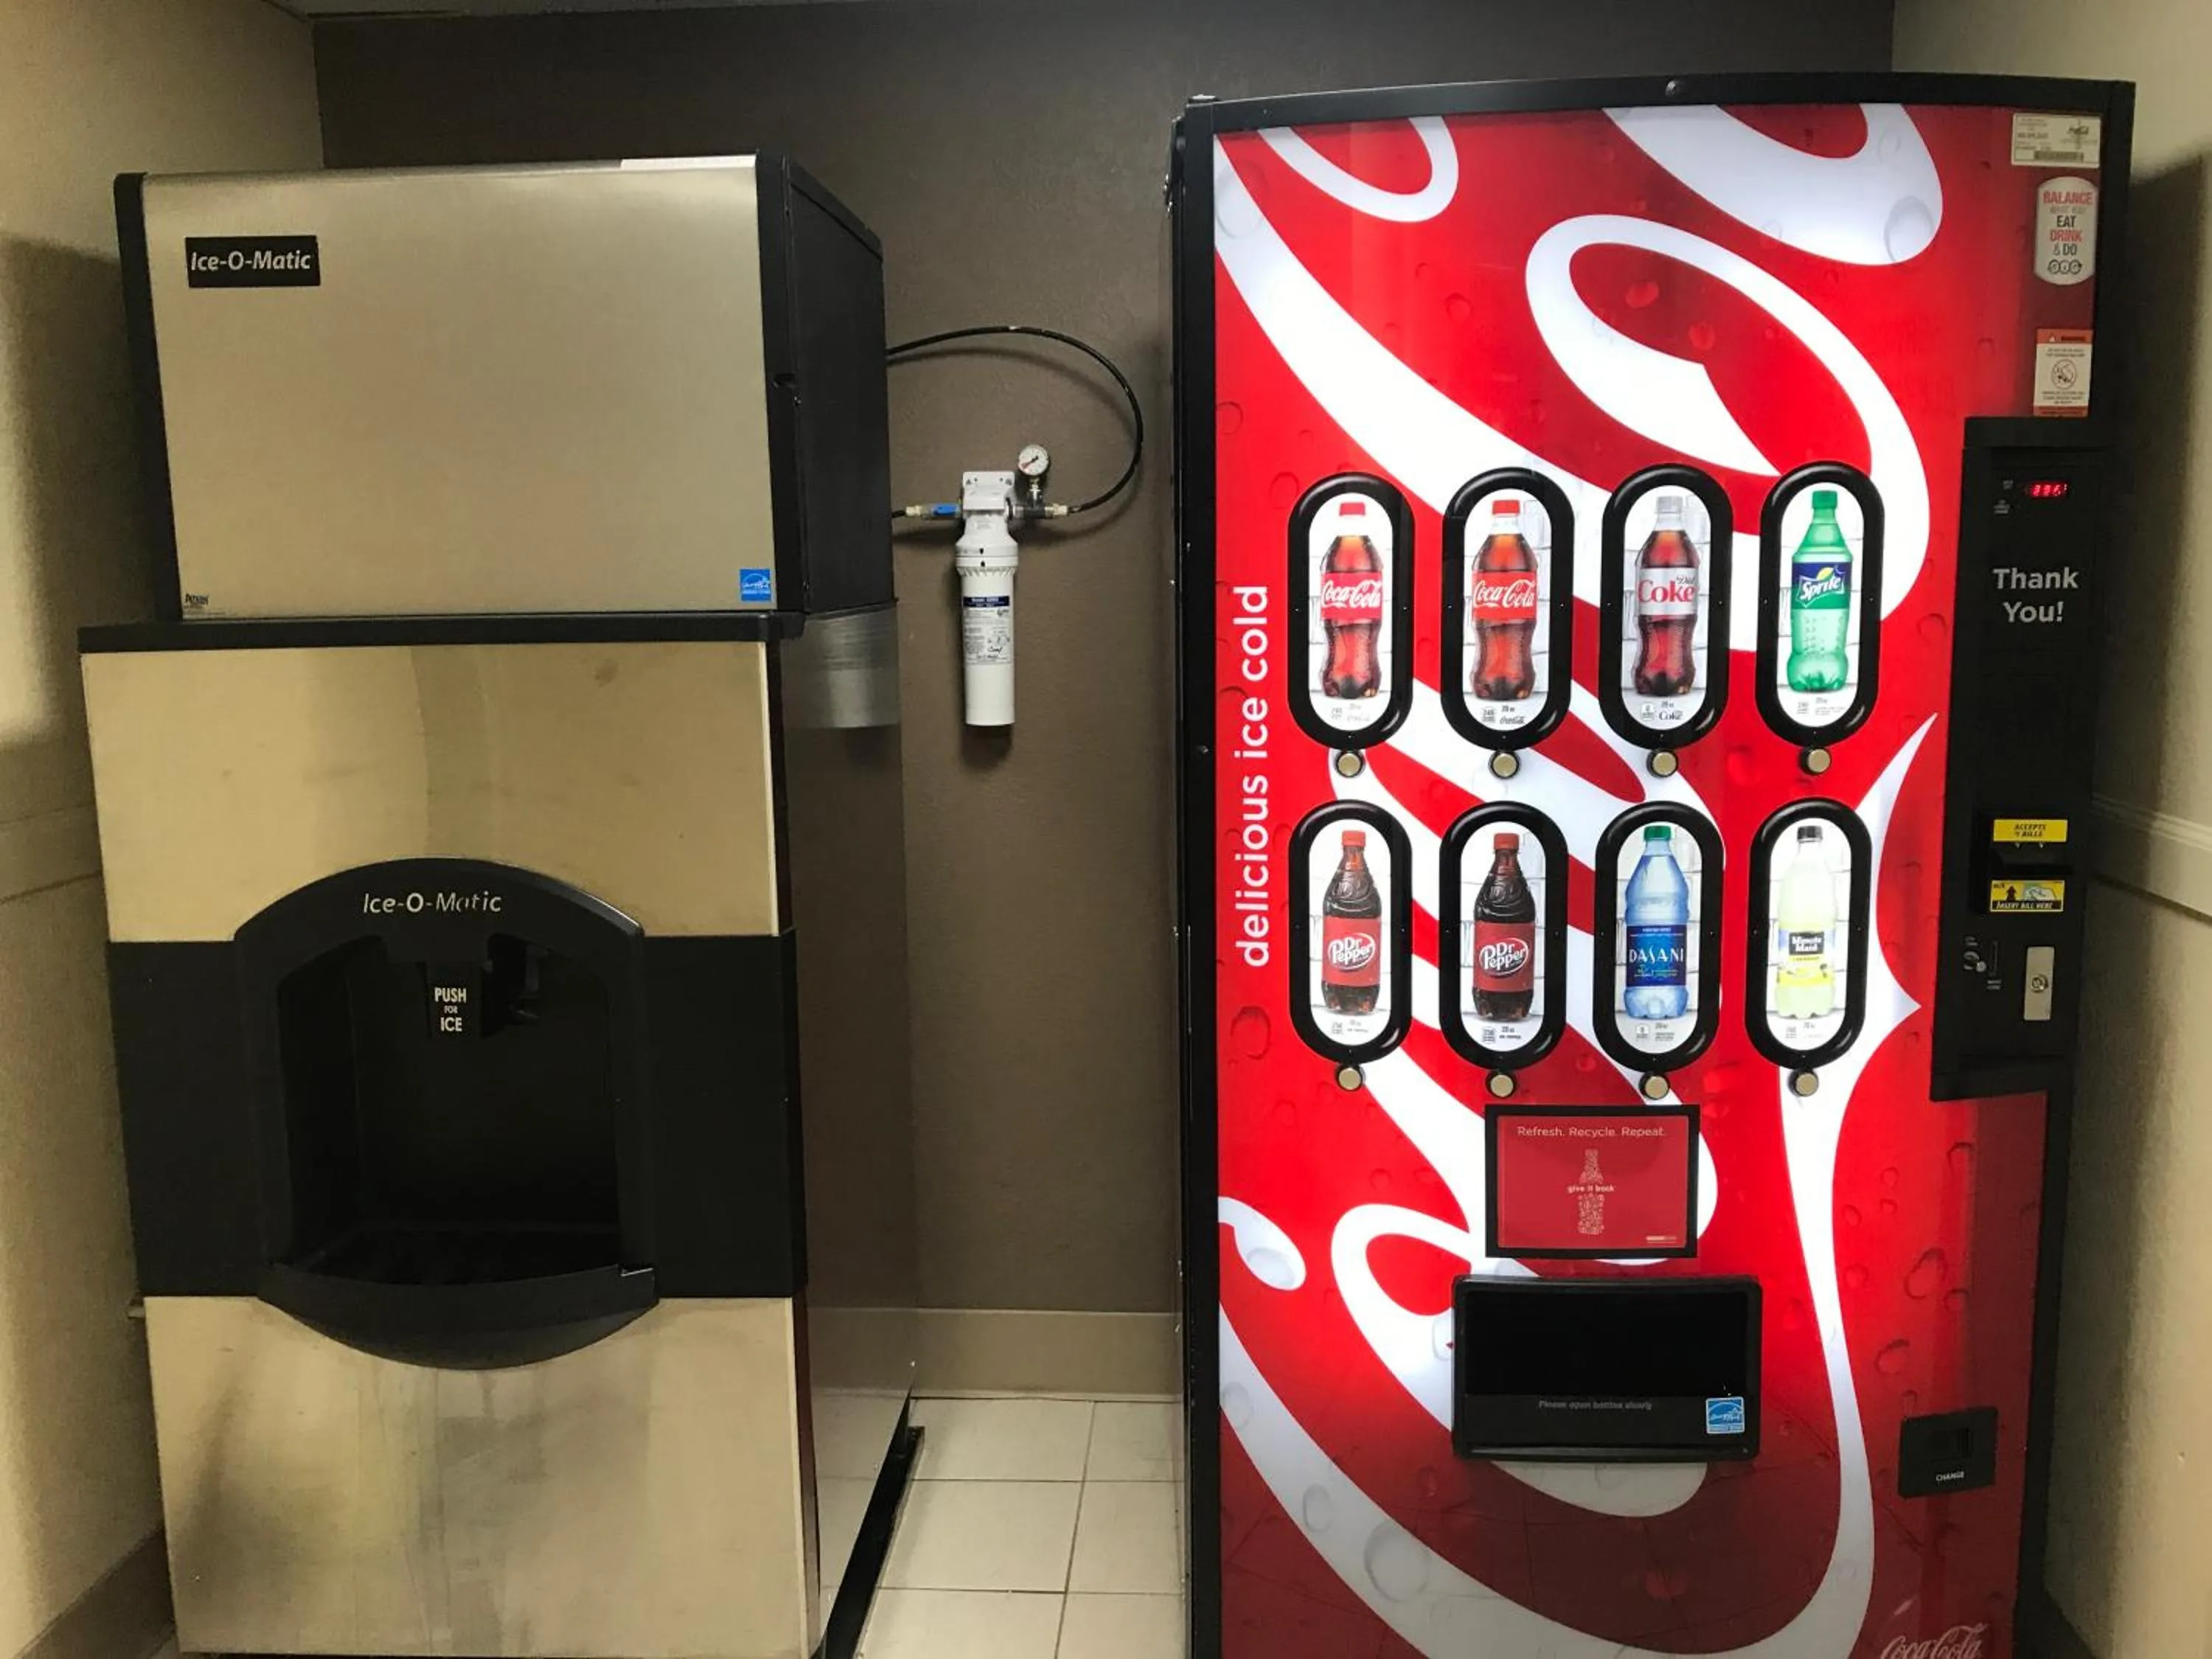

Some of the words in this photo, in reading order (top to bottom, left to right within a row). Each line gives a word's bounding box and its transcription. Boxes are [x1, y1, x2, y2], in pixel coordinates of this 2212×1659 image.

[2043, 191, 2093, 205] BALANCE
[2056, 215, 2076, 227] EAT
[2050, 229, 2083, 242] DRINK
[190, 249, 311, 271] Ice-O-Matic
[2062, 243, 2078, 256] DO
[1800, 573, 1841, 601] Sprite
[1993, 566, 2079, 591] Thank
[1321, 579, 1382, 609] Coca-Cola
[1473, 578, 1536, 609] Coca-Cola
[1638, 579, 1699, 603] Coke
[2003, 600, 2065, 623] You!
[1232, 586, 1268, 682] cold
[1234, 696, 1269, 759] ice
[1235, 773, 1270, 968] delicious
[364, 890, 502, 914] Ice-O-Matic
[1332, 939, 1371, 965] Pepper
[1344, 936, 1363, 950] Dr
[1496, 942, 1515, 956] Dr
[1484, 945, 1524, 970] Pepper
[1628, 945, 1684, 964] DASANI
[434, 987, 467, 1003] PUSH
[444, 1005, 458, 1014] FOR
[440, 1017, 463, 1032] ICE
[1517, 1126, 1565, 1137] Refresh.
